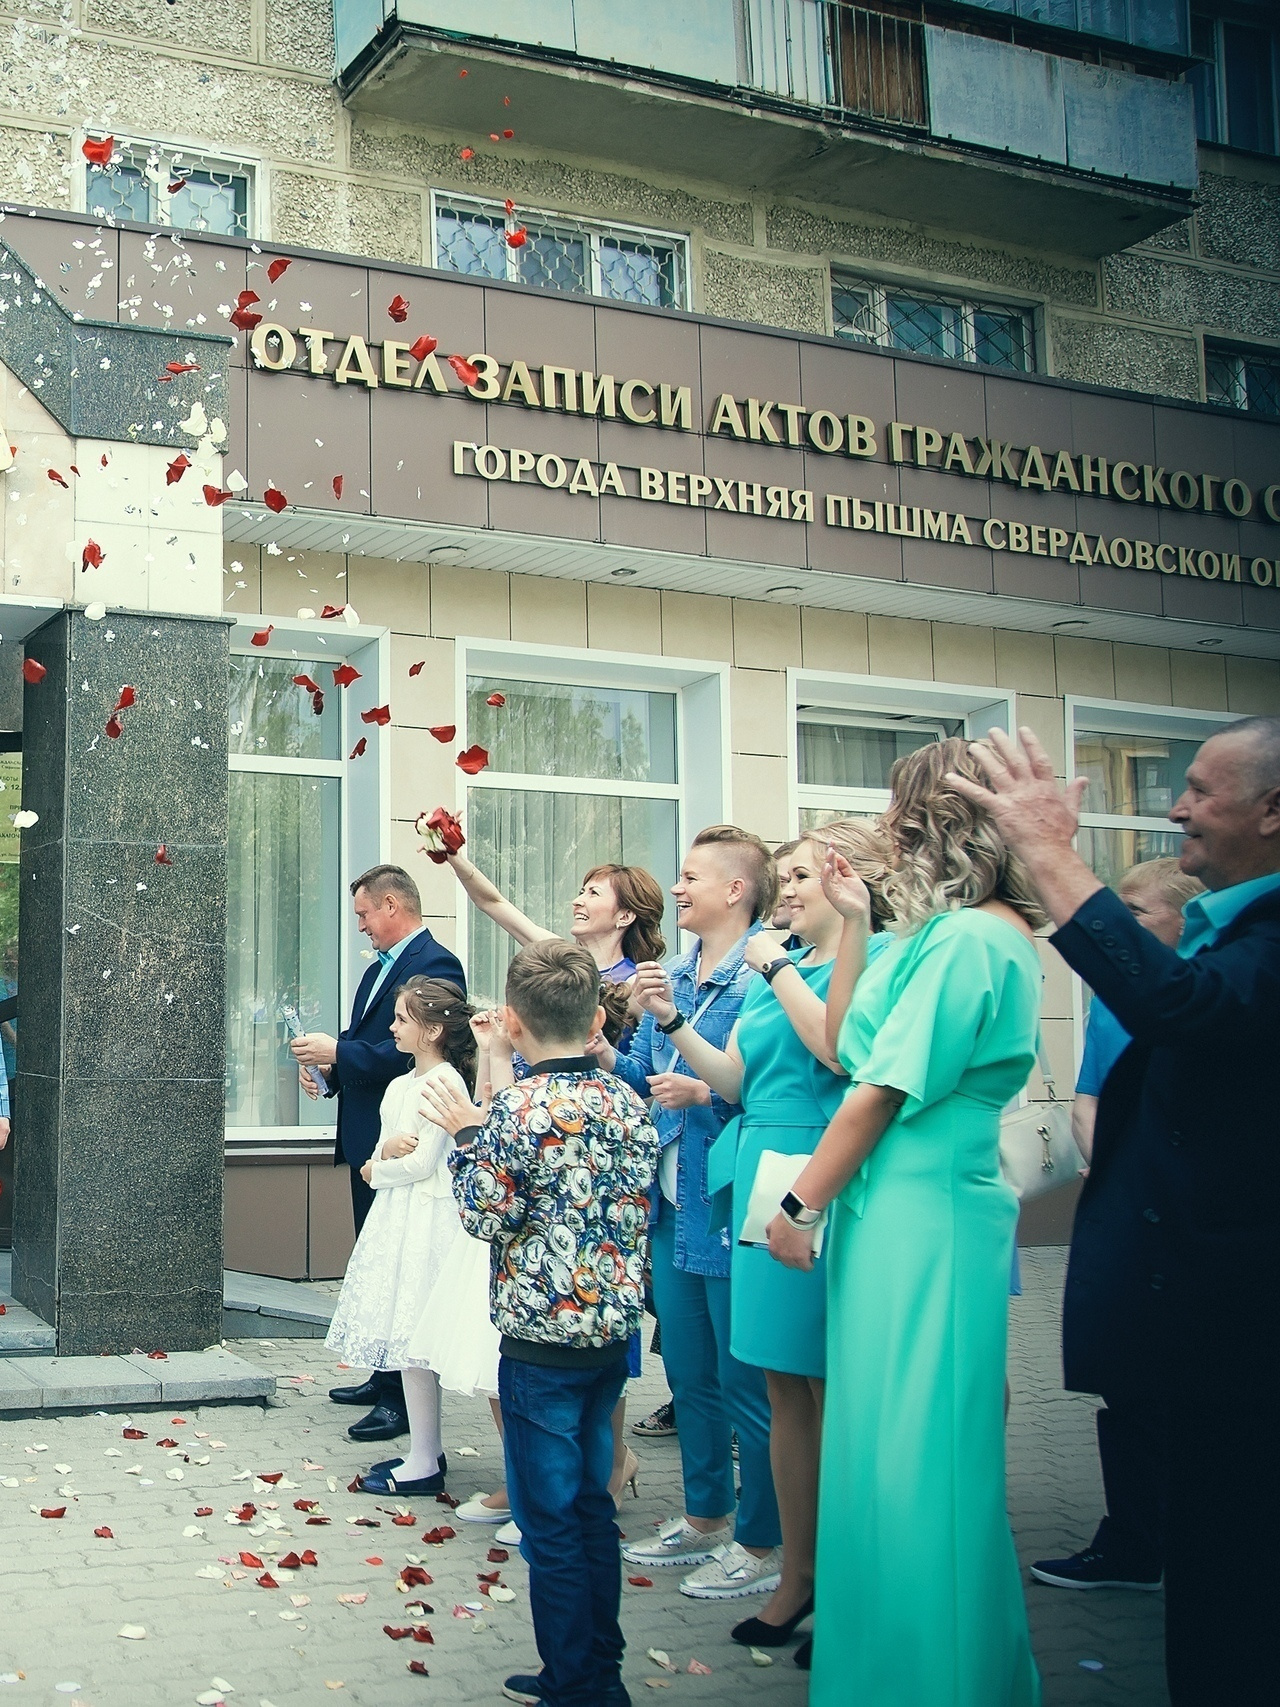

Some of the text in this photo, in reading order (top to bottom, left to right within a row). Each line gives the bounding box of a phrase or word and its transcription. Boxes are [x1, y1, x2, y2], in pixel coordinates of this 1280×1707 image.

[250, 323, 448, 393] ОТДЕЛ
[465, 353, 693, 430] ЗАПИСИ
[710, 393, 878, 457] АКТОВ
[887, 422, 1253, 518] ГРАЖДАНСКОГО
[452, 440, 627, 498] ГОРОДА
[639, 466, 814, 523] ВЕРХНЯЯ
[826, 493, 973, 546] ПЫШМА
